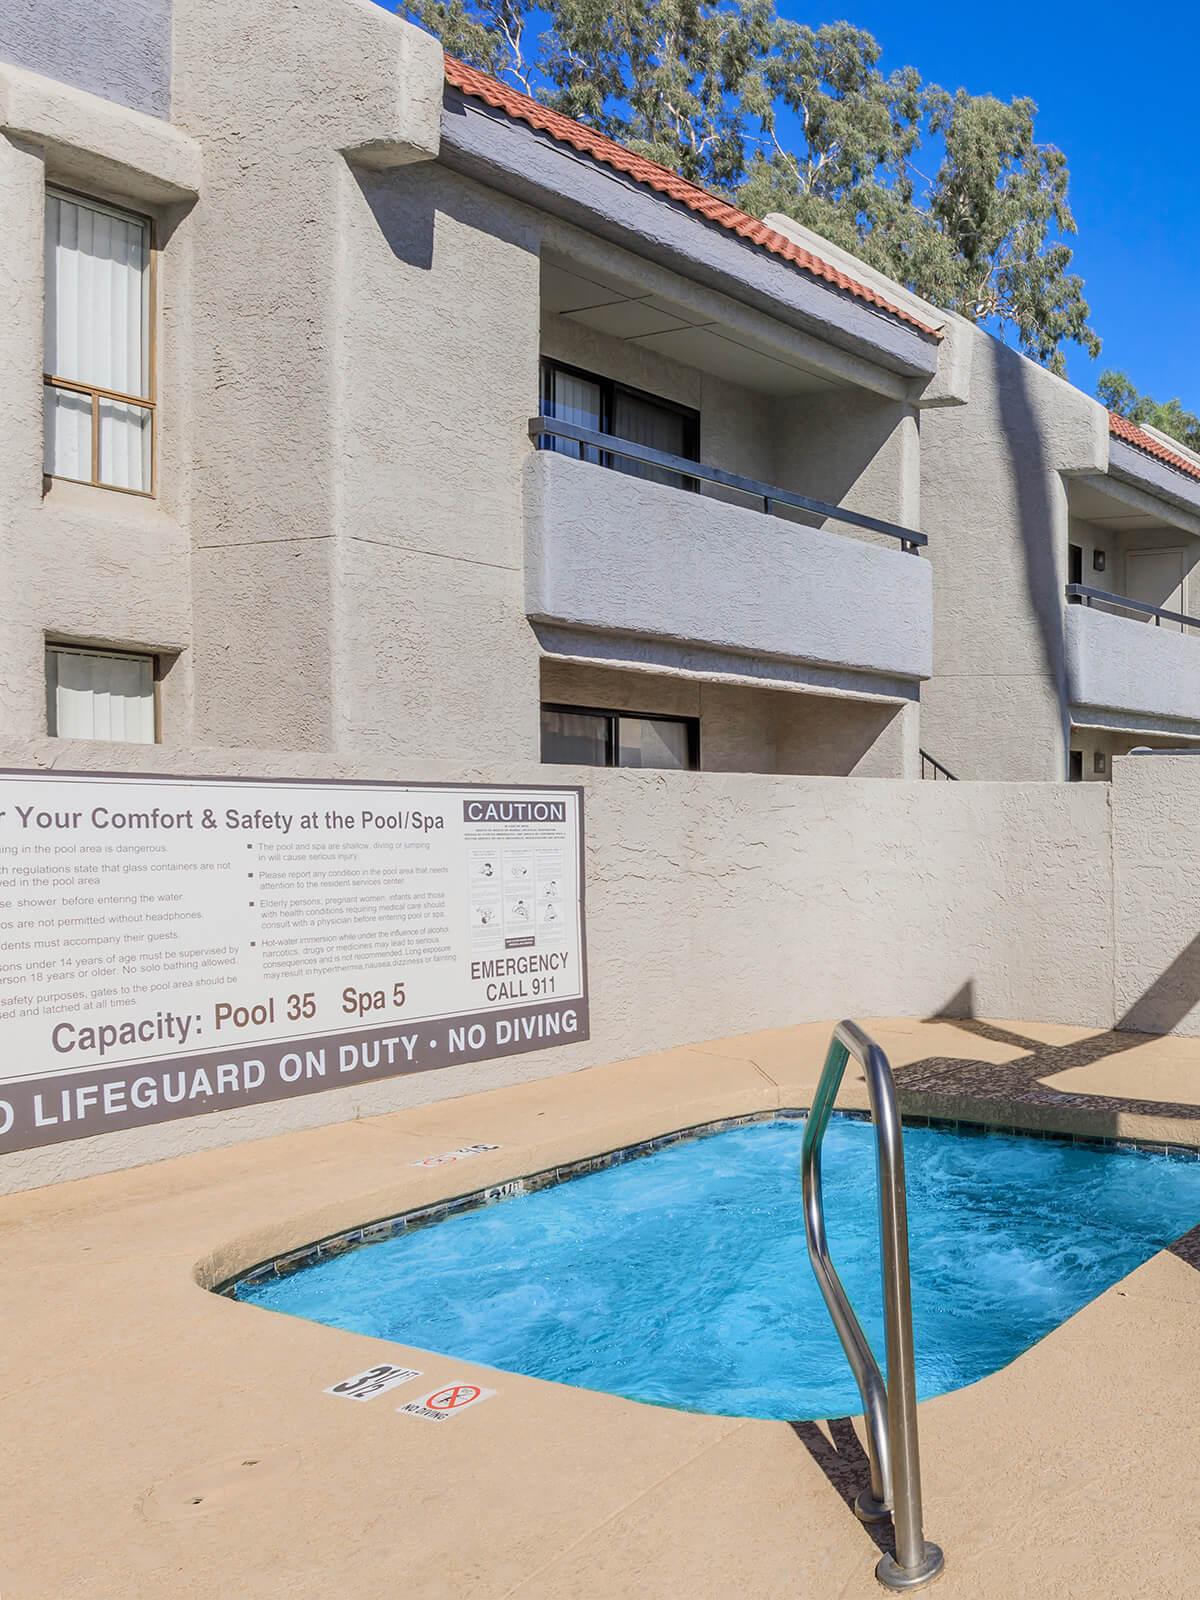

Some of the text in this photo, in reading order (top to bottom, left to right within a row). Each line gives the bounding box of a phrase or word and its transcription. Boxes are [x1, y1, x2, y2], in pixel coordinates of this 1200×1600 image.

[15, 806, 82, 828] Your
[91, 807, 194, 829] Comfort
[201, 808, 218, 829] &
[226, 808, 293, 834] Safety
[300, 811, 319, 829] at
[324, 810, 355, 829] the
[362, 811, 444, 832] Pool/Spa
[468, 802, 563, 820] CAUTION
[22, 843, 30, 853] in
[35, 843, 50, 853] the
[54, 843, 78, 855] pool
[105, 843, 113, 852] is
[12, 863, 70, 876] regulations
[74, 863, 98, 873] state
[102, 862, 120, 872] that
[123, 862, 147, 874] glass
[150, 862, 198, 871] containers
[218, 861, 231, 870] not
[20, 877, 29, 887] in
[33, 876, 49, 886] the
[52, 876, 74, 888] pool
[18, 897, 56, 908] shower
[62, 895, 94, 905] before
[98, 894, 137, 904] entering
[140, 892, 155, 902] the
[18, 920, 34, 928] are
[38, 917, 54, 927] not
[58, 914, 105, 928] permitted
[108, 912, 142, 923] without
[34, 938, 60, 949] must
[64, 936, 120, 947] accompany
[124, 933, 144, 943] their
[26, 959, 56, 970] under
[61, 957, 72, 967] 14
[76, 957, 103, 969] years
[106, 954, 116, 964] of
[119, 954, 136, 965] age
[140, 950, 162, 961] must
[165, 950, 176, 959] be
[179, 945, 226, 959] supervised
[229, 945, 239, 956] by
[471, 952, 568, 980] EMERGENCY
[31, 972, 43, 982] 18
[48, 971, 75, 983] years
[78, 970, 88, 978] or
[123, 964, 136, 974] No
[140, 962, 160, 972] solo
[164, 960, 198, 970] bathing
[91, 986, 118, 1000] gates
[121, 984, 130, 994] to
[133, 983, 147, 993] the
[150, 980, 170, 993] pool
[196, 975, 224, 986] should
[227, 974, 237, 983] be
[486, 976, 556, 1002] CALL 911
[20, 1006, 39, 1017] and
[43, 1001, 80, 1014] latched
[84, 1000, 94, 1010] at
[97, 998, 107, 1009] all
[52, 982, 406, 1055] Capacity: Pool 35 Spa 5
[34, 1060, 266, 1127] LIFEGUARD
[279, 1049, 326, 1082] ON
[339, 1034, 418, 1072] DUTY
[449, 1024, 486, 1053] NO
[496, 1010, 578, 1044] DIVING
